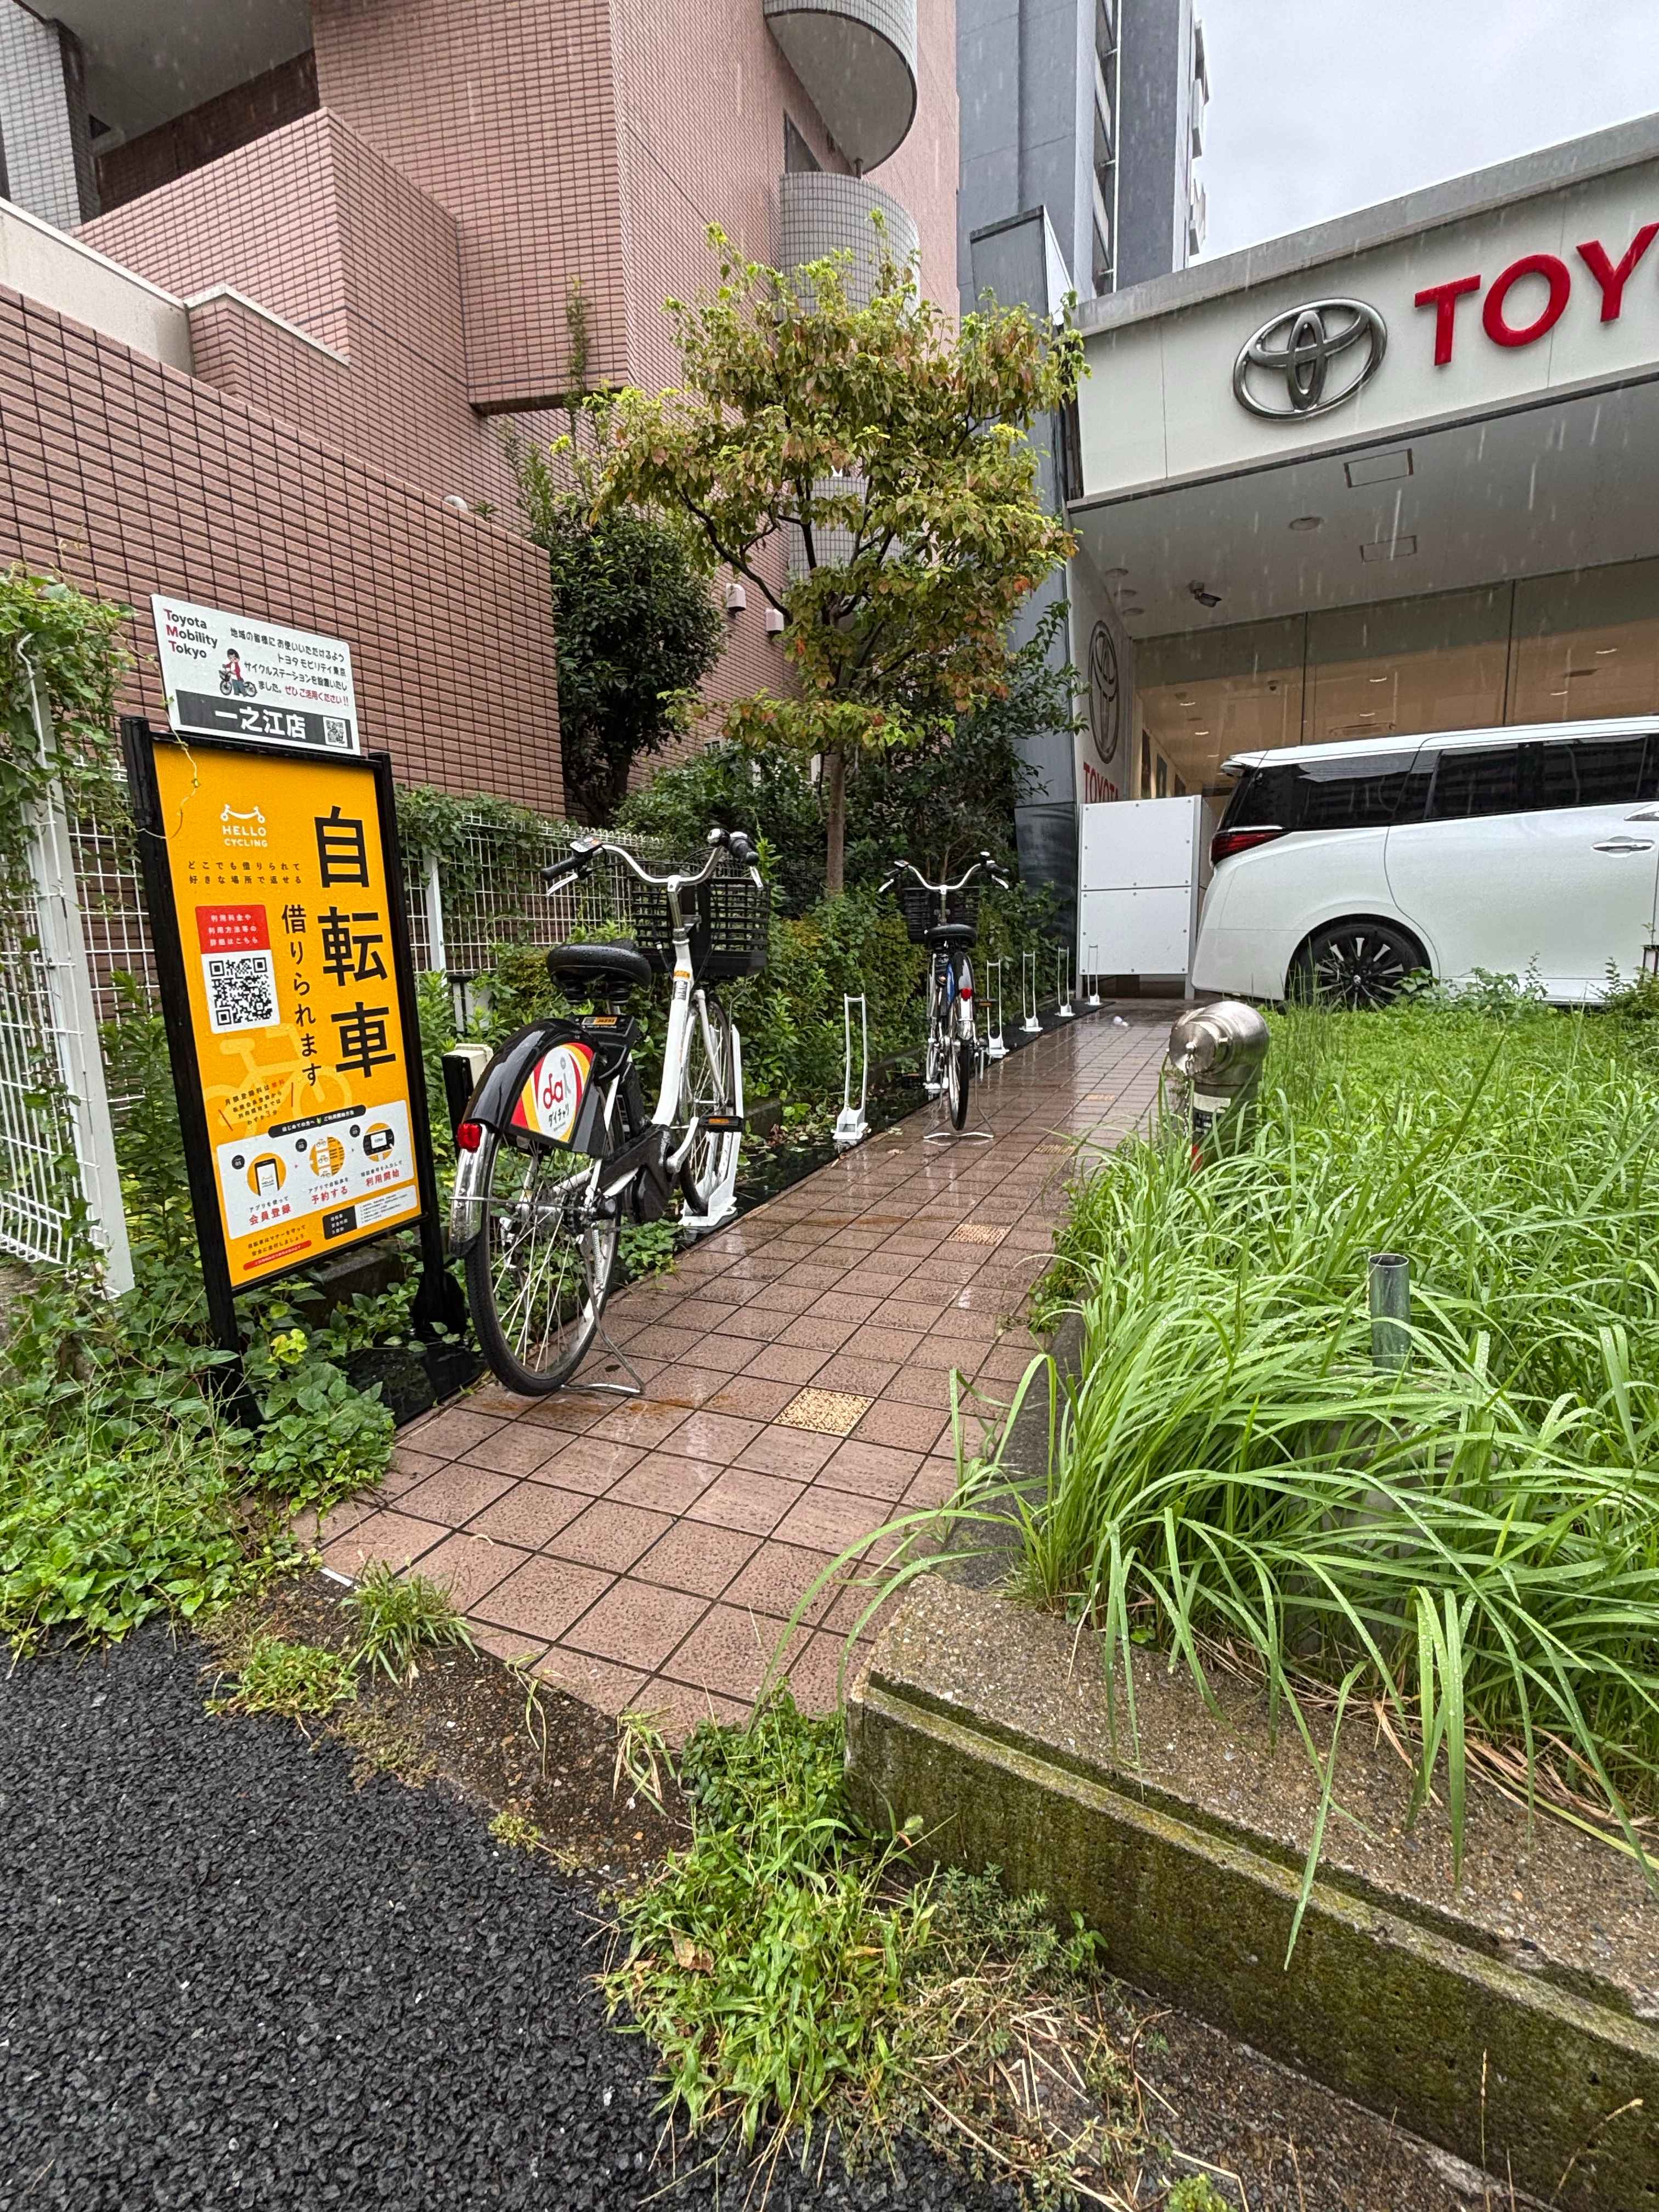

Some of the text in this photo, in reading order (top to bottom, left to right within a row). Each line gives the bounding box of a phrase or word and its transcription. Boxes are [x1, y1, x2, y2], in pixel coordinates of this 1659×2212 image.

[163, 608, 207, 629] Toyota
[166, 624, 218, 648] Mobility
[168, 640, 207, 659] Tokyo
[215, 707, 306, 740] 一之江店
[222, 825, 267, 837] HELLO
[224, 838, 268, 847] CYCLING
[188, 861, 300, 871] どこでも借りられて
[189, 876, 302, 885] 好きな場所で返せる
[314, 805, 396, 1078] 自転車
[281, 904, 322, 1087] 借りられます
[549, 1103, 569, 1127] ダイチャリ
[365, 1170, 400, 1188] 利用開始
[311, 1186, 348, 1205] 予約する
[249, 1204, 291, 1226] 会員登録
